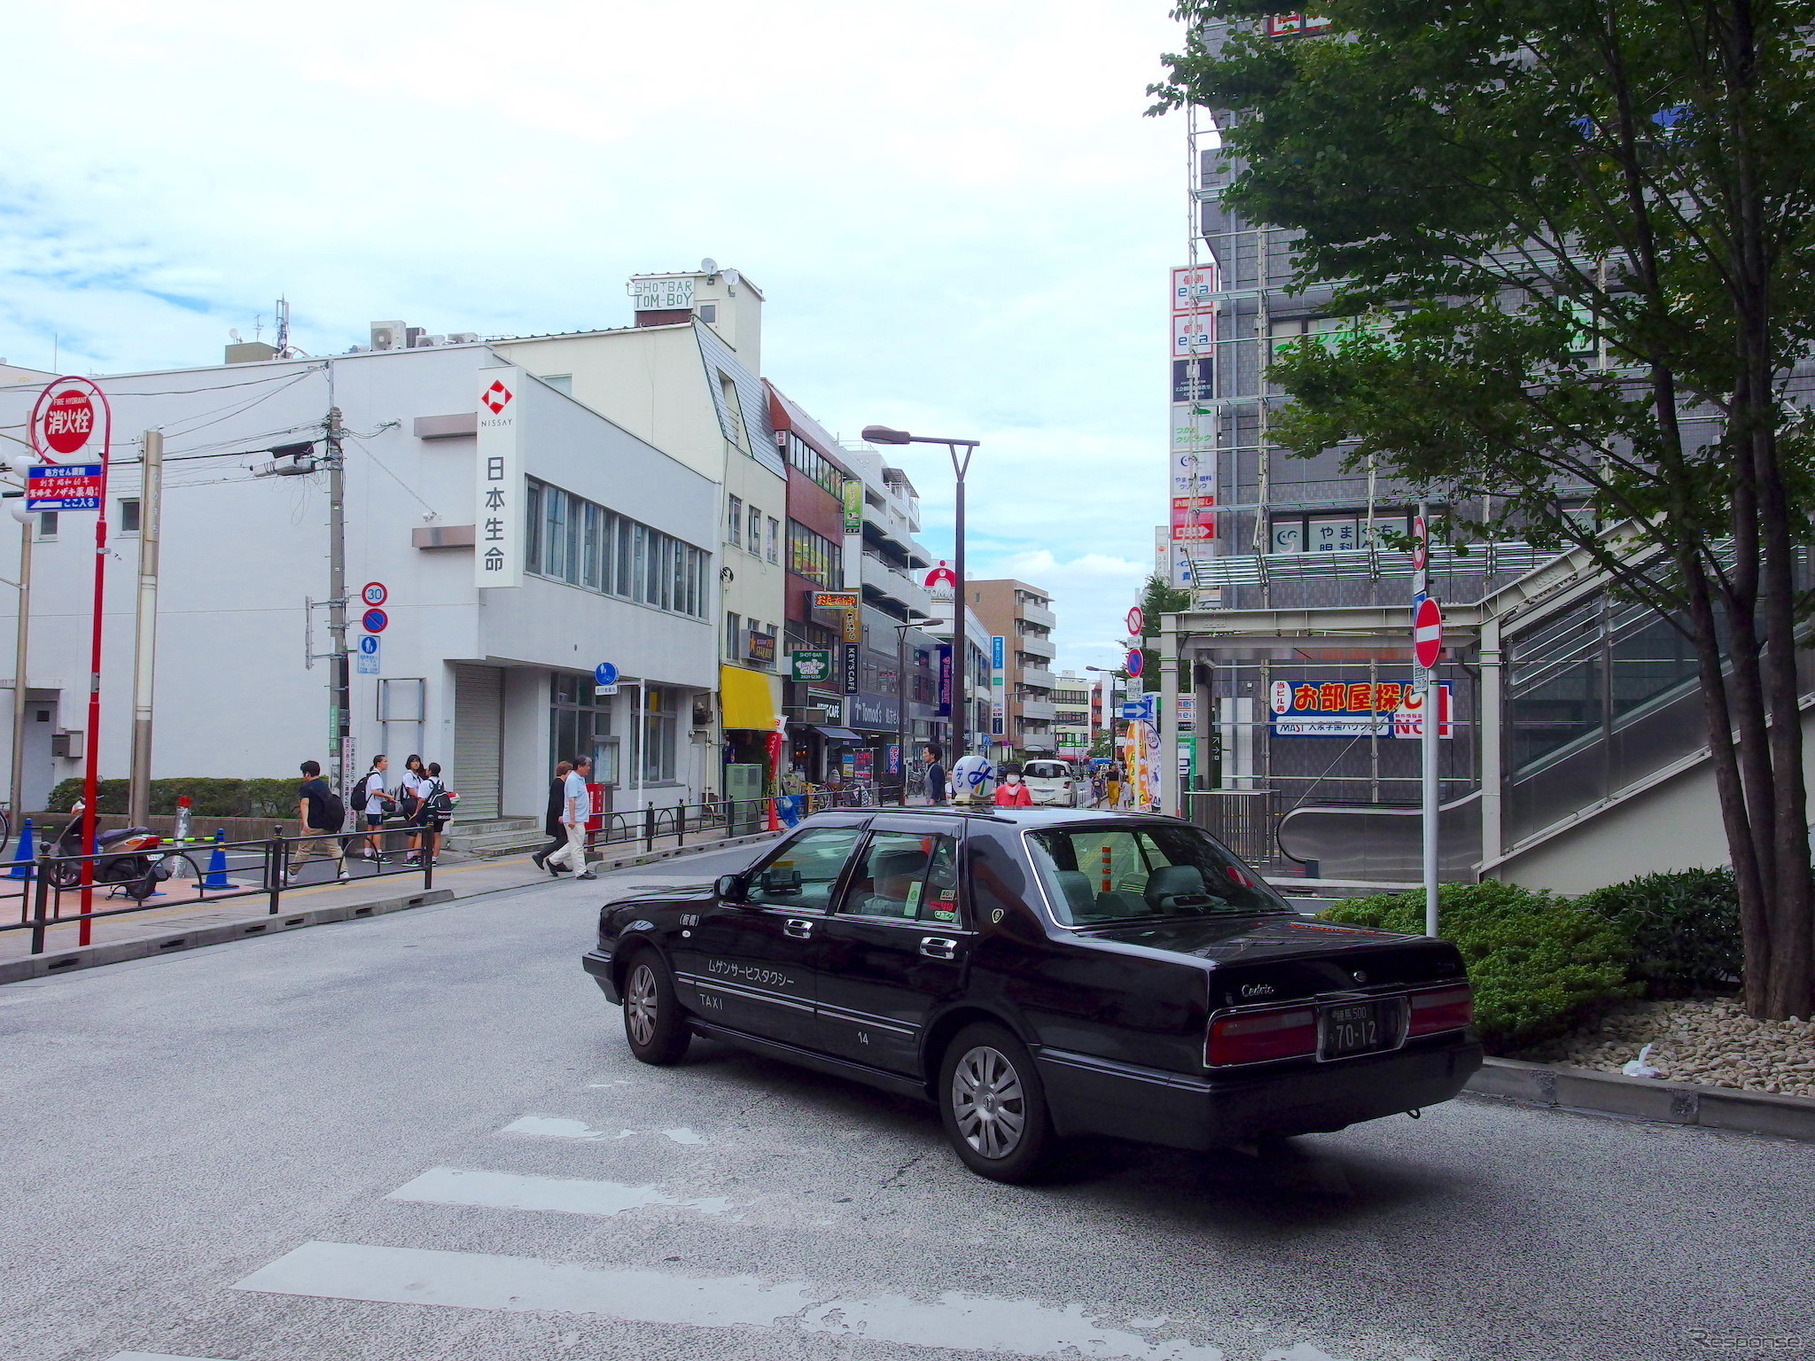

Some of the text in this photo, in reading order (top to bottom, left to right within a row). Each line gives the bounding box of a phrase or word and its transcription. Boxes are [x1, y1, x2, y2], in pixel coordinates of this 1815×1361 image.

[1178, 285, 1208, 297] ea
[1178, 334, 1208, 346] ea
[53, 396, 87, 406] FIRE HYDRANT
[48, 407, 91, 435] 消火栓
[481, 418, 513, 428] NISSAY
[1175, 475, 1212, 483] やま眼科
[64, 498, 95, 507] ここ入る
[484, 456, 506, 572] 日本生命
[367, 588, 382, 600] 30
[1294, 682, 1423, 712] お部屋探し
[862, 701, 882, 724] Tomod's
[1280, 722, 1304, 733] MAST
[709, 959, 795, 987] ムゲンサービスタクシー
[1241, 983, 1274, 998] Cedric
[699, 994, 724, 1010] TAXI
[1352, 1006, 1367, 1020] 500
[857, 1031, 869, 1045] 14
